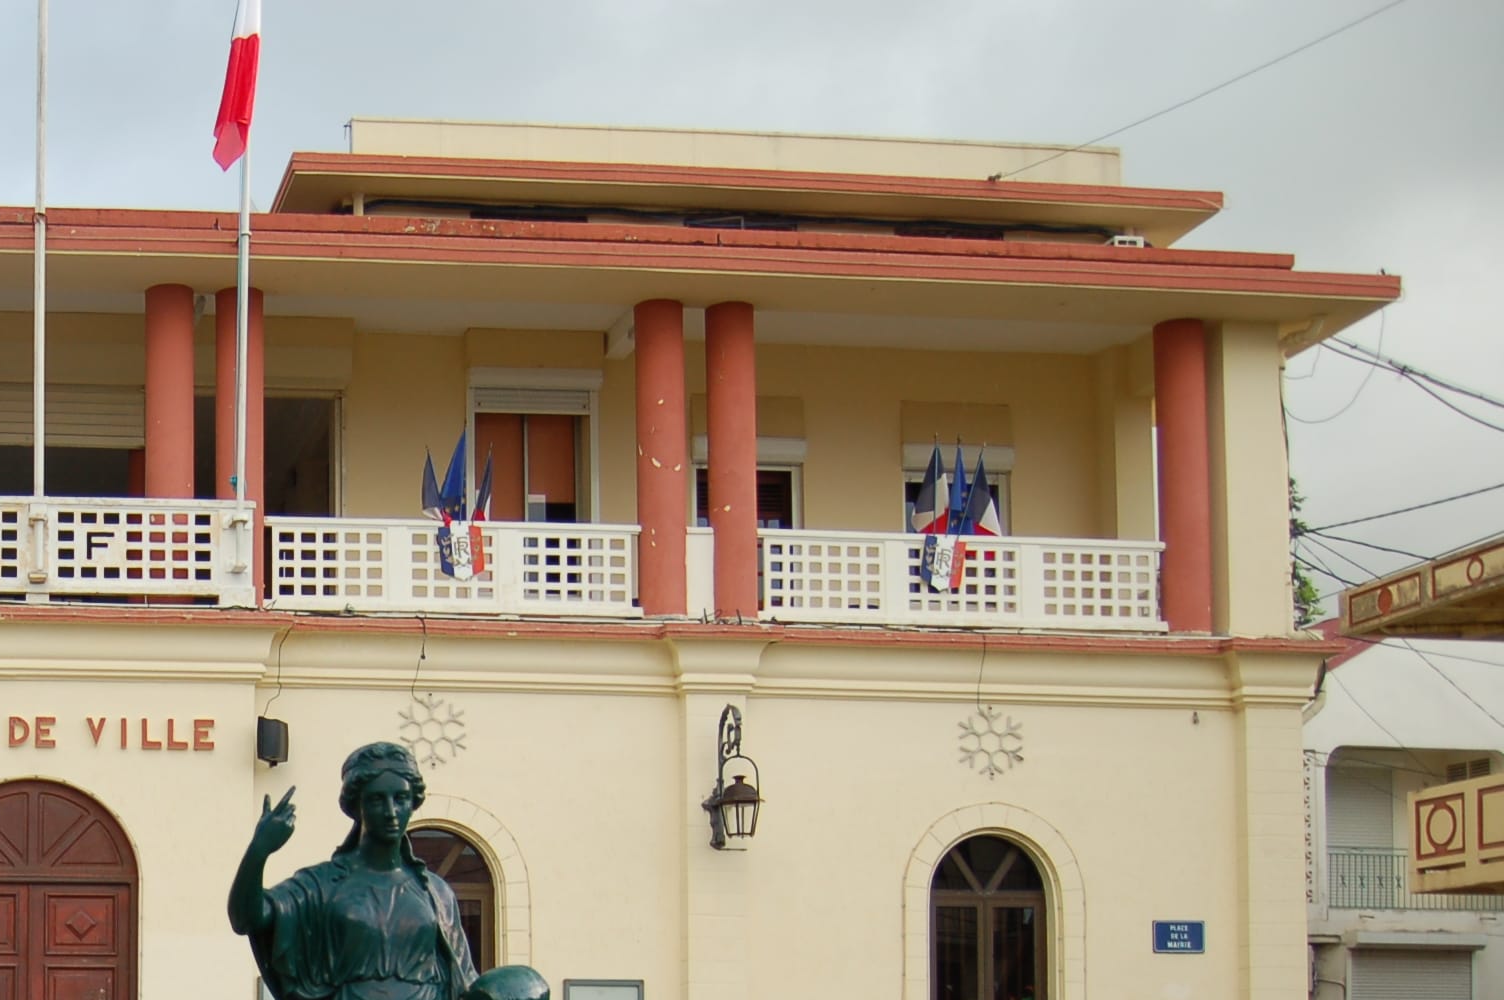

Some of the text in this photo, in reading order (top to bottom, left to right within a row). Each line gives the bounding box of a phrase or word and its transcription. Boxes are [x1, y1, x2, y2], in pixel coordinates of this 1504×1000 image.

[86, 532, 115, 560] F
[8, 716, 56, 748] DE
[86, 717, 215, 751] VILLE
[1169, 924, 1189, 932] PLACE
[1167, 941, 1192, 949] MAIRIE
